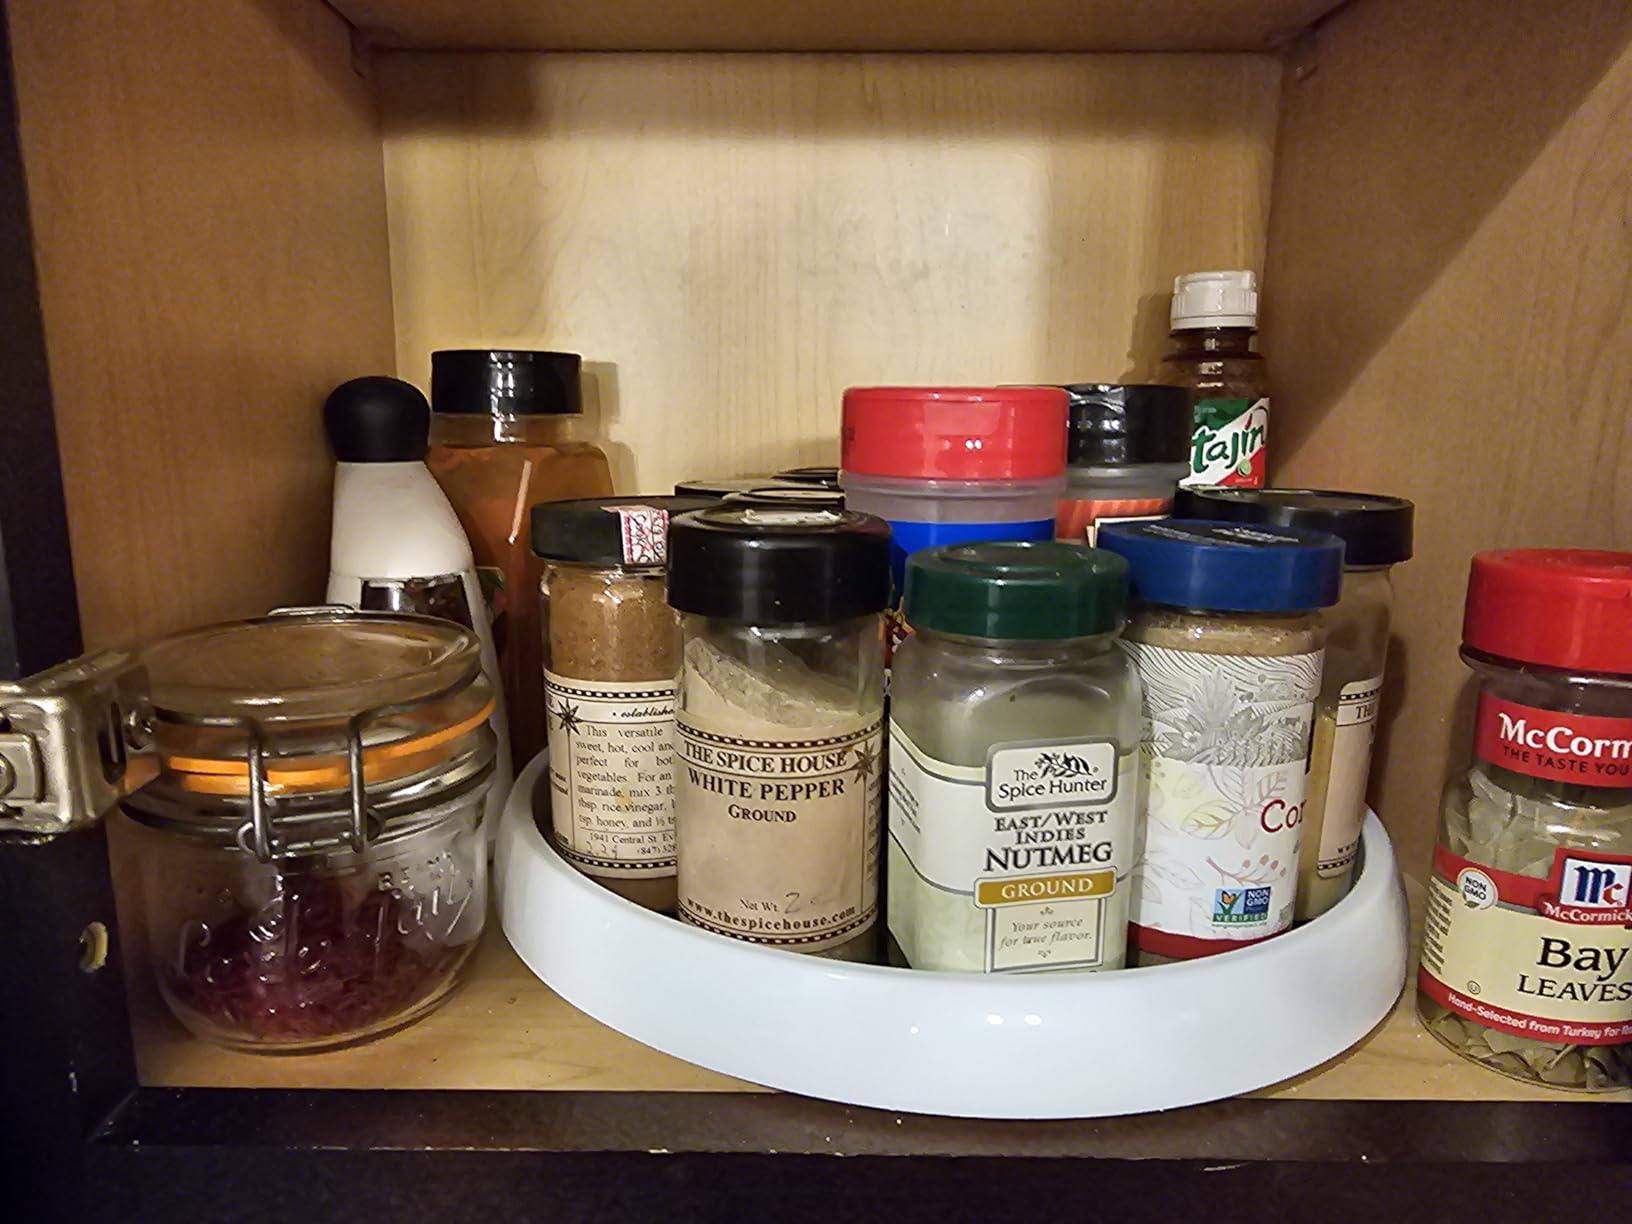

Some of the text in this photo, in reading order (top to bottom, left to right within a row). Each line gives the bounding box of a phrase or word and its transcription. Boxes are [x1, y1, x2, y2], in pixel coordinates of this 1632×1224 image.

[586, 725, 663, 737] This versatile
[576, 742, 605, 753] sweet,
[608, 742, 628, 753] hot,
[631, 741, 655, 753] cool
[576, 755, 608, 766] perfect
[624, 757, 639, 768] for
[684, 740, 847, 773] THE SPICE HOUSE
[1503, 745, 1630, 777] THE TASTE YOU
[637, 772, 656, 782] For
[659, 772, 672, 780] an
[1014, 769, 1038, 781] The
[629, 788, 651, 797] mix
[655, 786, 662, 796] 3
[687, 767, 845, 800] WHITE PEPPER
[998, 779, 1107, 801] Spice Hunter
[602, 803, 621, 812] rice
[728, 804, 797, 822] GROUND
[632, 817, 652, 828] and
[994, 810, 1108, 832] EAST/WEST
[590, 832, 608, 842] 1941
[612, 834, 645, 845] Central
[1015, 827, 1086, 845] INDIES
[983, 842, 1113, 872] NUTMEG
[1001, 878, 1094, 899] GROUND
[1465, 876, 1487, 892] NON
[1248, 889, 1269, 898] NON
[1464, 886, 1487, 900] GMO
[740, 898, 759, 911] Net
[1246, 897, 1269, 906] GMO
[687, 898, 856, 930] www.thespicehouse.com
[1216, 912, 1267, 921] VERIFIED
[1544, 901, 1632, 922] McCormick
[1012, 919, 1083, 932] Your source
[999, 931, 1092, 950] for true flavor.
[1536, 936, 1630, 982] Bay
[1517, 974, 1632, 1002] LEAVES
[1448, 993, 1527, 1029] Hand-Selected
[1529, 1021, 1560, 1038] from
[1563, 1025, 1601, 1039] Turkey
[1603, 1025, 1621, 1037] for
